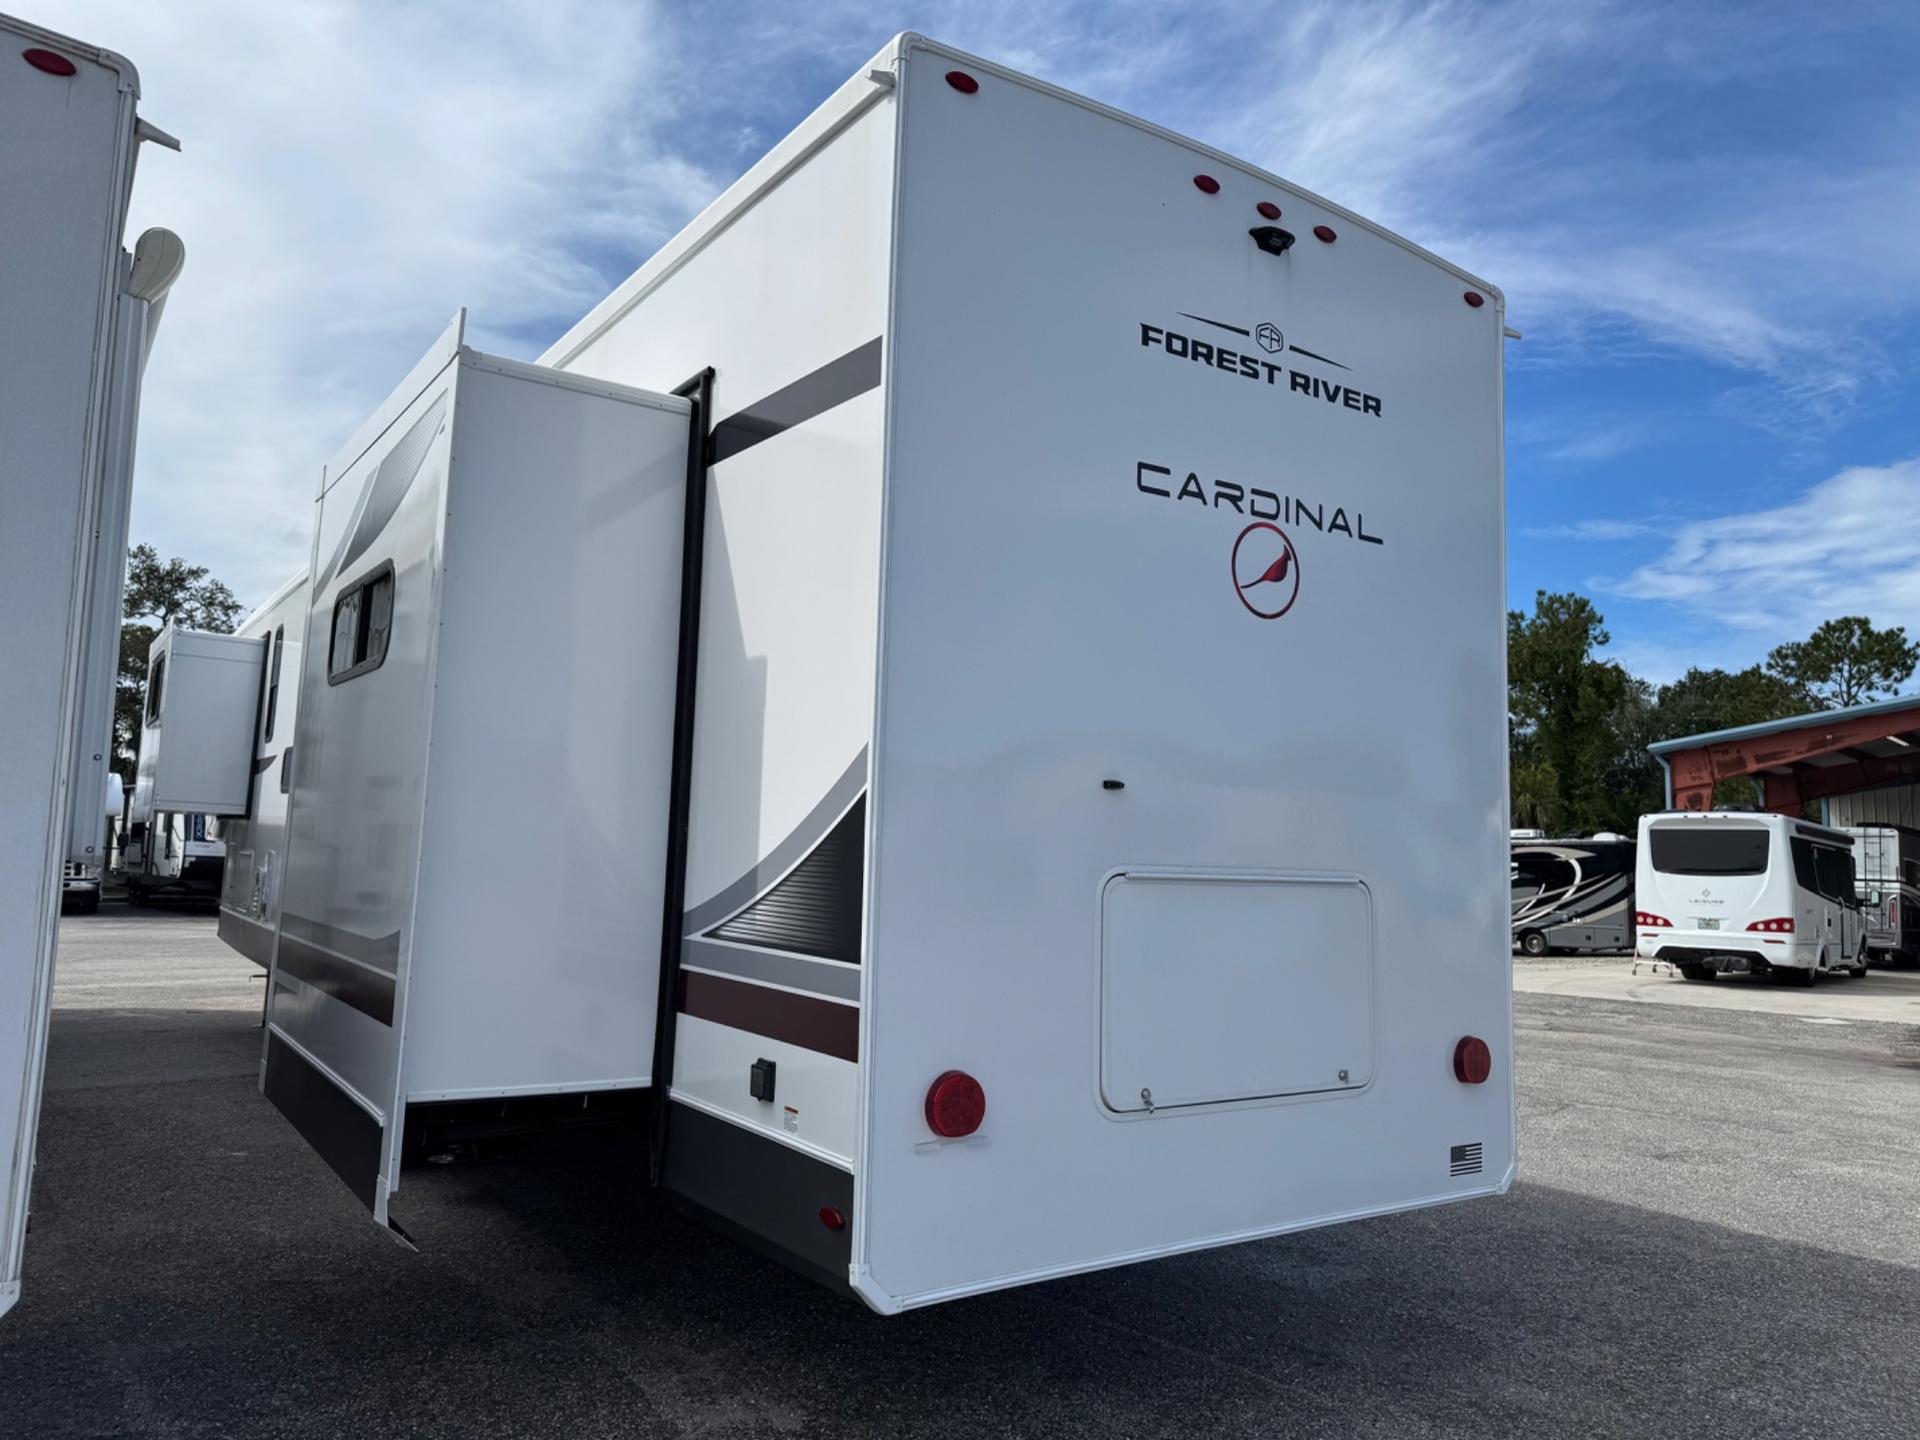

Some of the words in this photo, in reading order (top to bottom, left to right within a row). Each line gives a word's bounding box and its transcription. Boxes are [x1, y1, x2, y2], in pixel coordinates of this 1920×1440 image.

[1140, 322, 1281, 384] FOREST
[1289, 369, 1381, 417] RIVER
[1137, 461, 1383, 545] CARDINAL
